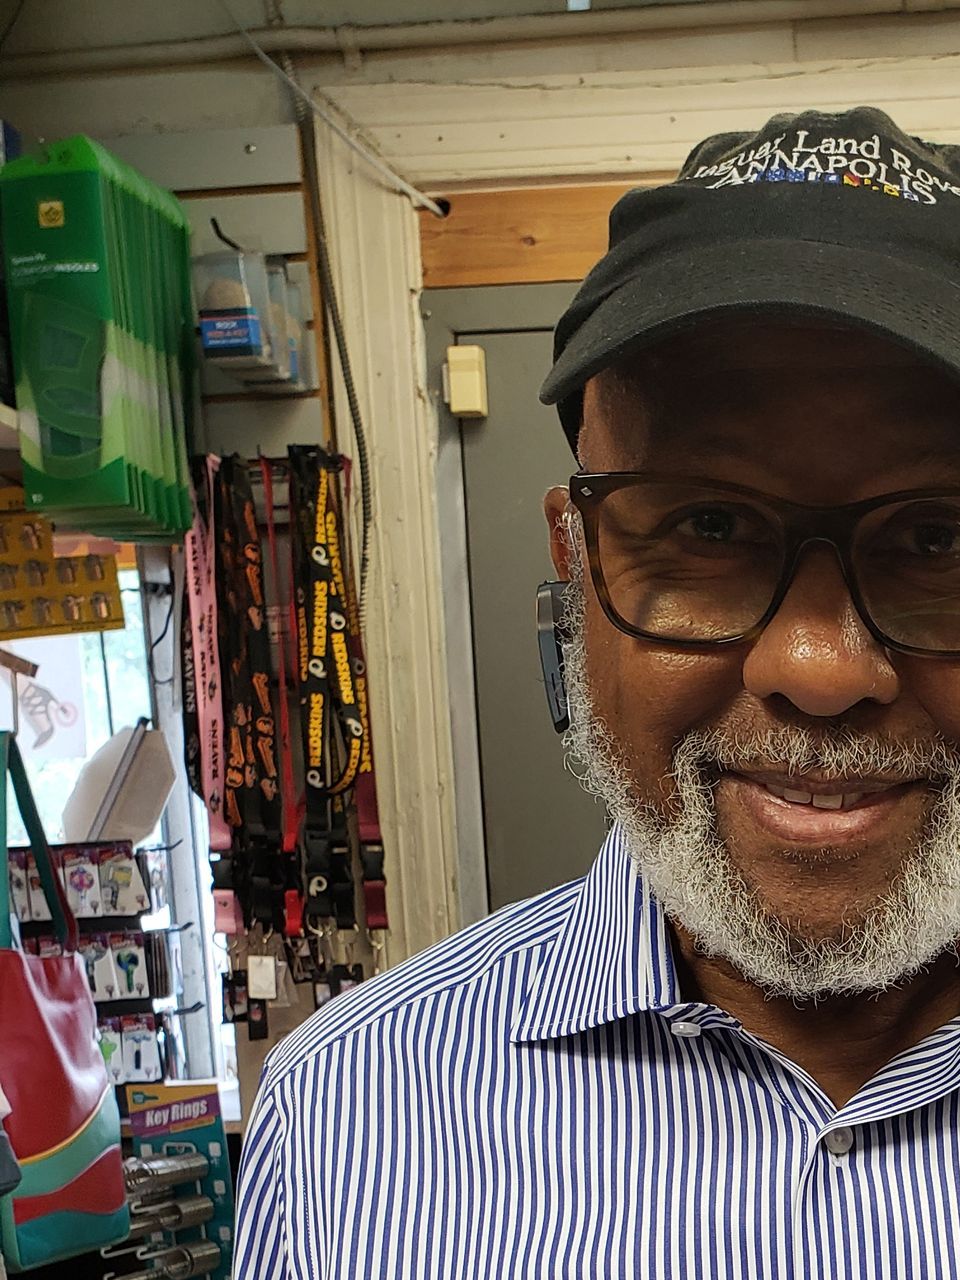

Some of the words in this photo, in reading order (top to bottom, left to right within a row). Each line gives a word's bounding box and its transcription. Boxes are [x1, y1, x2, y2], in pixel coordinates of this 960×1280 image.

[793, 130, 881, 160] Land
[706, 150, 937, 206] ANNAPOLIS
[313, 580, 328, 657] REDSKINS
[331, 632, 355, 705] REDSKINS
[210, 719, 220, 781] RAVENS
[309, 691, 324, 768] REDSKINS
[145, 1108, 170, 1129] Key
[171, 1099, 208, 1123] Rings
